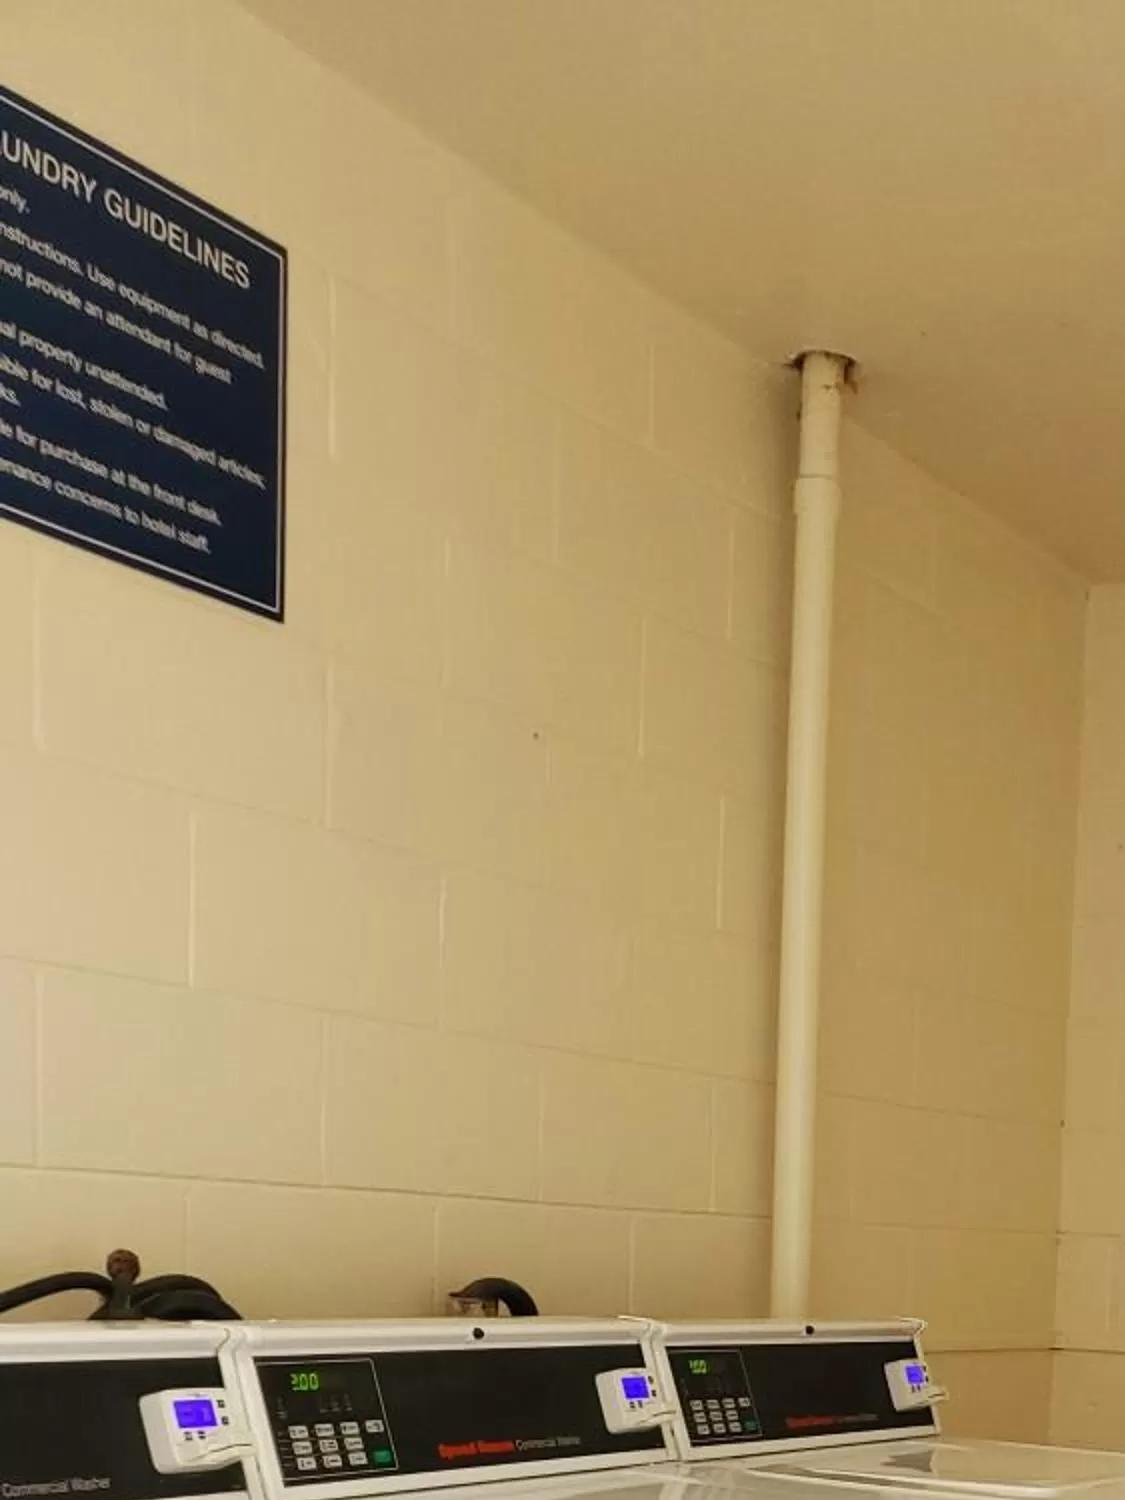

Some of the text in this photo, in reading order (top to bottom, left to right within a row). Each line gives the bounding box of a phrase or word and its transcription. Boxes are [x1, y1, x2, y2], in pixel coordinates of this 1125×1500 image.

[0, 129, 250, 289] UNDRY GUIDELINES
[25, 271, 82, 311] provide
[83, 301, 104, 321] an
[104, 310, 171, 354] attendant
[173, 341, 193, 364] for
[87, 263, 116, 292] Use
[118, 283, 190, 331] equipment
[192, 321, 209, 340] as
[18, 329, 82, 373] property
[31, 367, 53, 392] for
[88, 398, 134, 428] stolen
[135, 418, 151, 436] or
[152, 425, 217, 467] damaged
[15, 424, 38, 449] for
[39, 439, 109, 480] purchase
[110, 468, 126, 488] at
[127, 472, 151, 497] the
[153, 483, 186, 512] front
[53, 480, 123, 520] concerns
[123, 506, 141, 526] to
[141, 509, 176, 540] hotel
